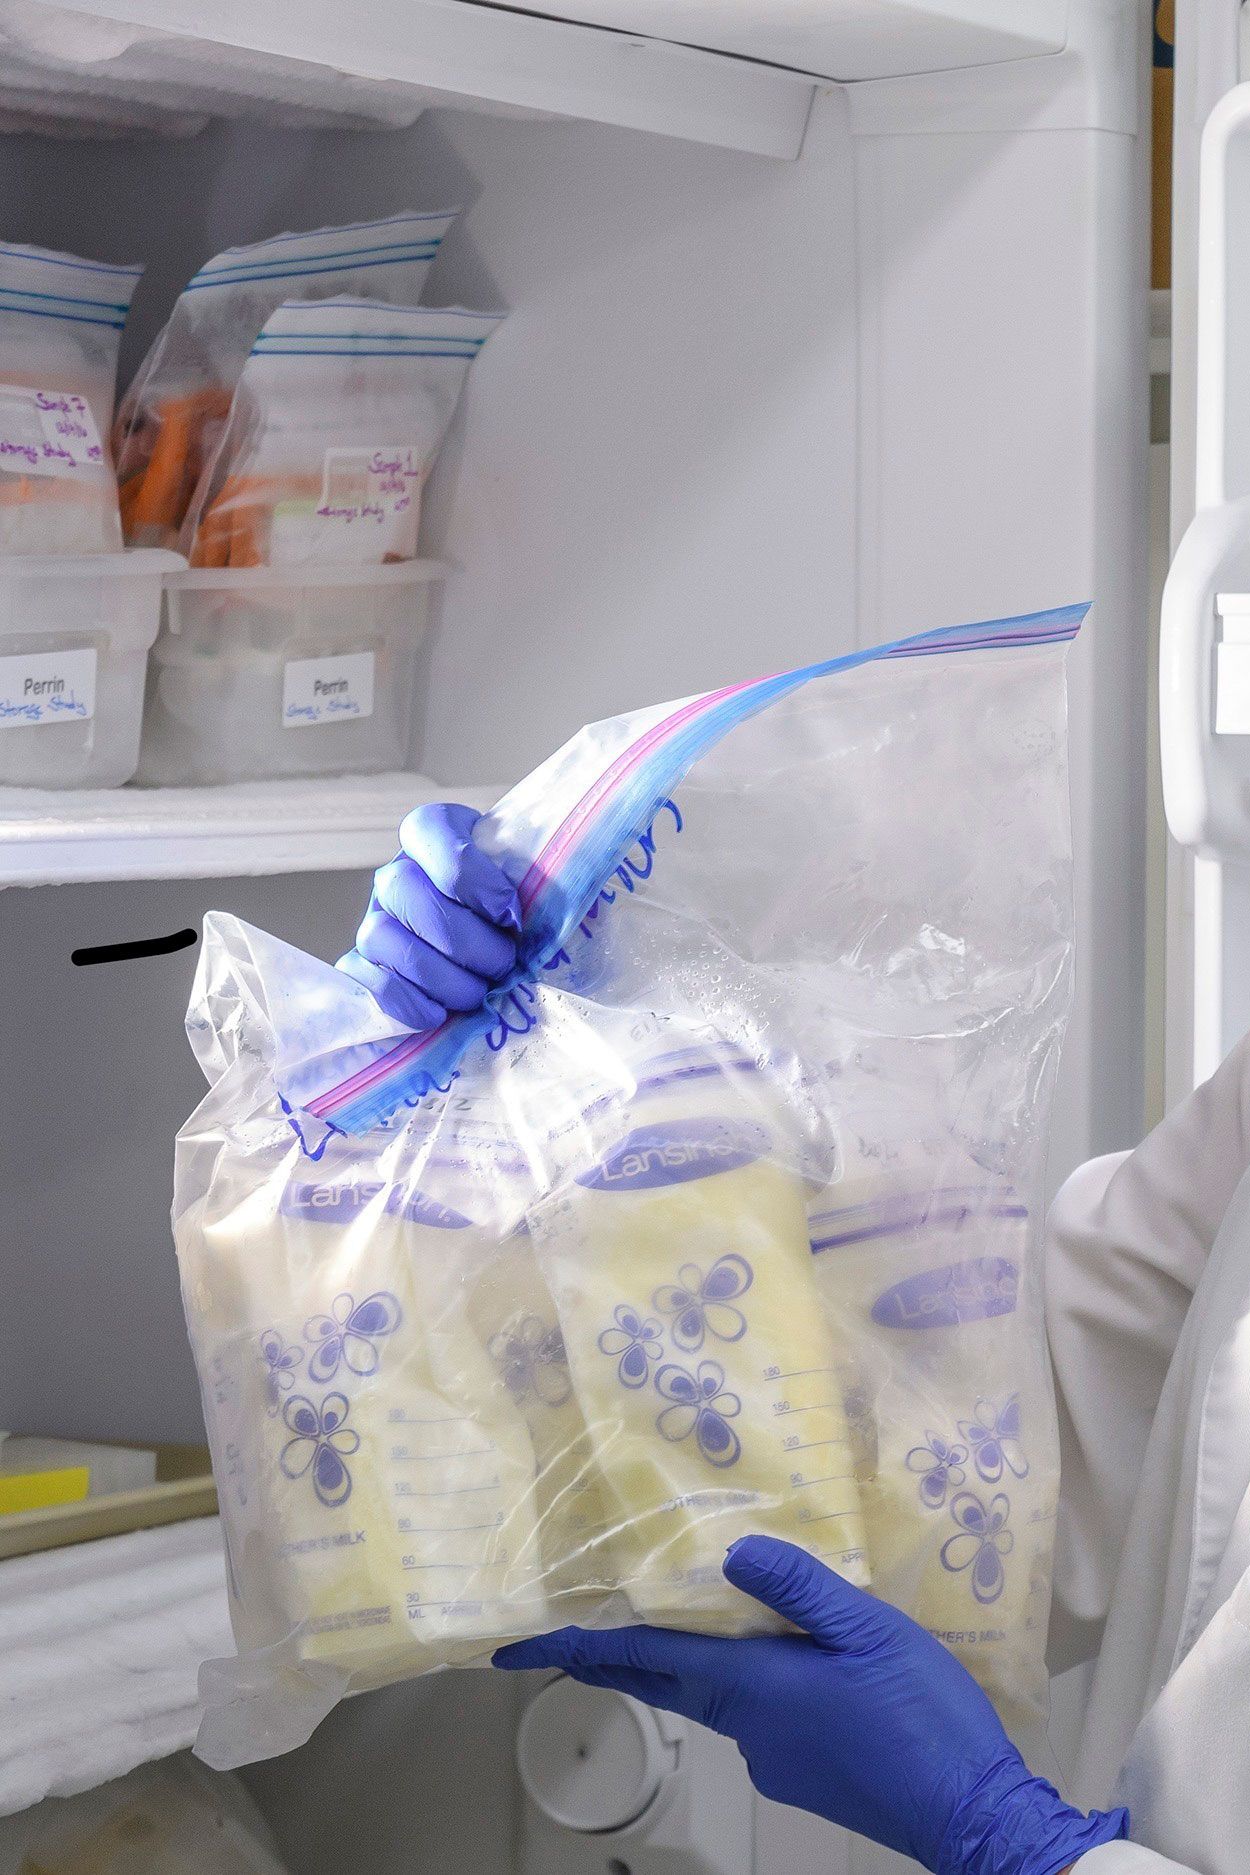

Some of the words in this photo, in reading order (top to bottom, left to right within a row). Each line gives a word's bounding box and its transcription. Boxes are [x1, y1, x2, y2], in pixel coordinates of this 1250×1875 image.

[24, 675, 65, 697] Perrin
[313, 676, 349, 697] Perrin
[333, 1530, 366, 1547] MILK
[402, 1555, 415, 1566] 60
[406, 1592, 420, 1603] 30
[408, 1609, 426, 1620] ML
